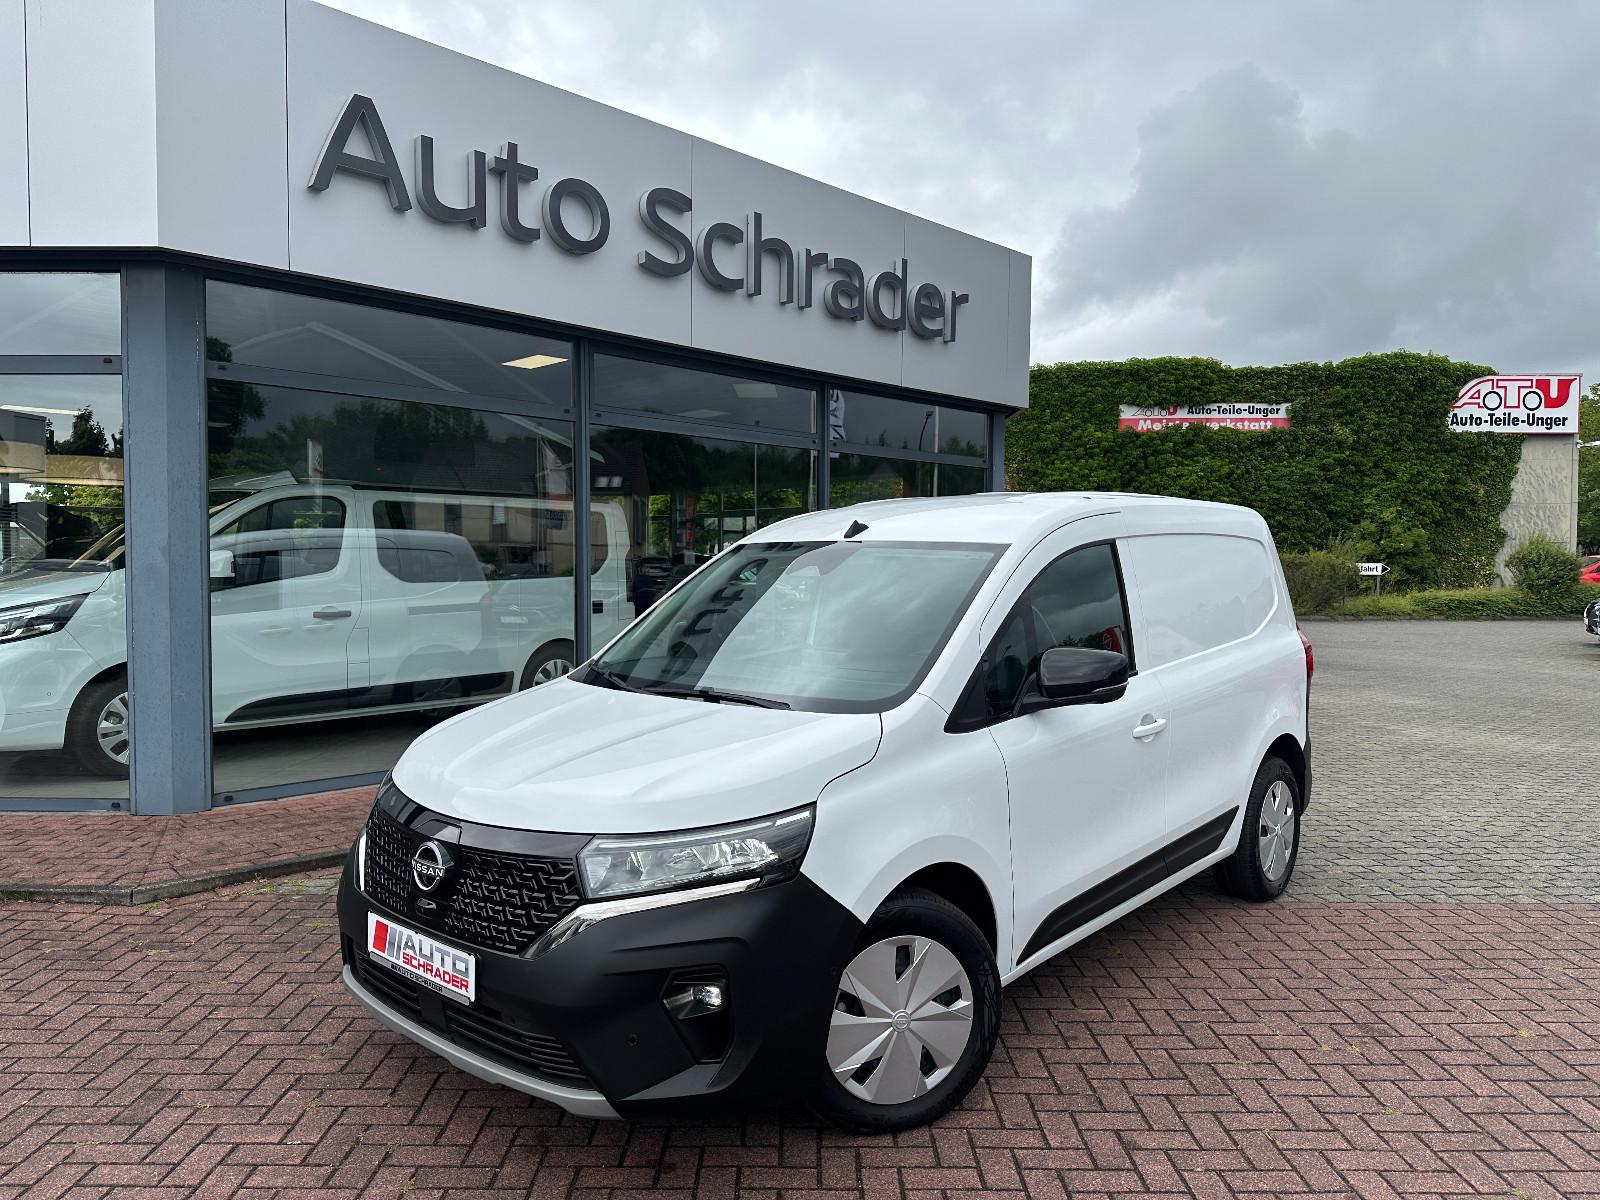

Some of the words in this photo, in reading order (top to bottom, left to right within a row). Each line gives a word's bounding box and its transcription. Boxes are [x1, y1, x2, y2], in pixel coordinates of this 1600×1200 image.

[308, 94, 610, 255] Auto
[637, 187, 969, 343] Schrader
[1187, 405, 1280, 417] Auto-Teile-Unger
[1138, 419, 1272, 430] Meieekstatt
[1450, 412, 1568, 430] Auto-Teile-Unger
[412, 860, 443, 877] NISSAN
[402, 934, 469, 979] AUTO
[402, 952, 469, 993] SCHRADER
